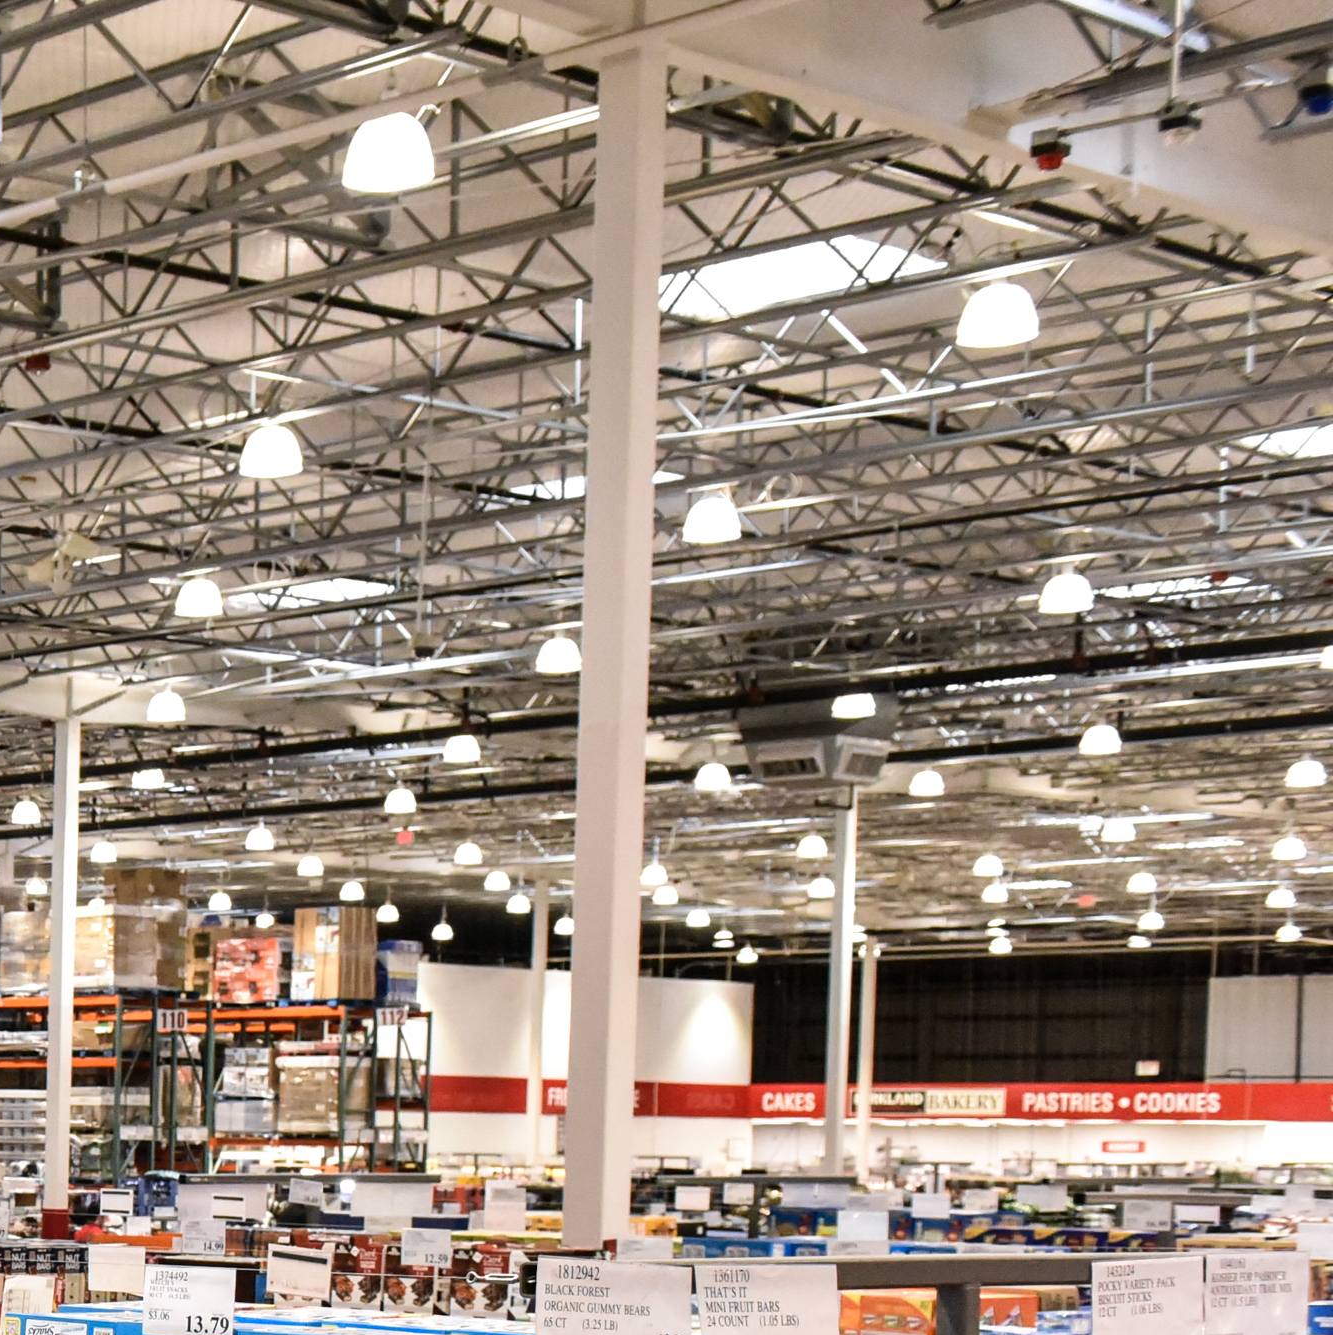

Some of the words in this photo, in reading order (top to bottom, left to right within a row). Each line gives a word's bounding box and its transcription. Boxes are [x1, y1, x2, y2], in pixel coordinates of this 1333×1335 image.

[160, 1011, 185, 1031] 110
[380, 1008, 407, 1025] 112
[761, 1092, 816, 1112] CAKES
[930, 1095, 1000, 1109] BAKERY
[1022, 1092, 1113, 1113] PASTRIES
[1134, 1092, 1220, 1113] COOKIES
[155, 1271, 188, 1281] 1374492
[557, 1265, 600, 1281] 1812942
[713, 1269, 750, 1283] 1361170
[1107, 1265, 1134, 1277] 1432124
[545, 1284, 575, 1296] BLACK
[576, 1285, 610, 1298] FOREST
[1098, 1280, 1121, 1292] POCKY
[1123, 1278, 1154, 1291] VARIETY
[1157, 1277, 1175, 1287] PACK
[704, 1287, 737, 1299] THAT'S
[738, 1287, 747, 1299] IT
[1098, 1295, 1125, 1305] BISCUIT
[1127, 1292, 1152, 1303] STICKS
[544, 1301, 585, 1313] ORGANIC
[587, 1302, 620, 1315] GUMMY
[622, 1304, 651, 1316] BEARS
[706, 1301, 724, 1312] MINI
[726, 1301, 754, 1313] FRUIT
[757, 1302, 780, 1313] BARS
[149, 1311, 170, 1320] $3.06
[707, 1315, 716, 1327] 24
[718, 1315, 749, 1327] COUNT
[759, 1315, 777, 1327] (1.05
[780, 1315, 800, 1327] LBS)
[186, 1316, 229, 1334] 13.79
[543, 1317, 554, 1329] 65
[555, 1318, 566, 1329] CT
[582, 1318, 601, 1330] (3.25
[604, 1319, 617, 1331] LB)
